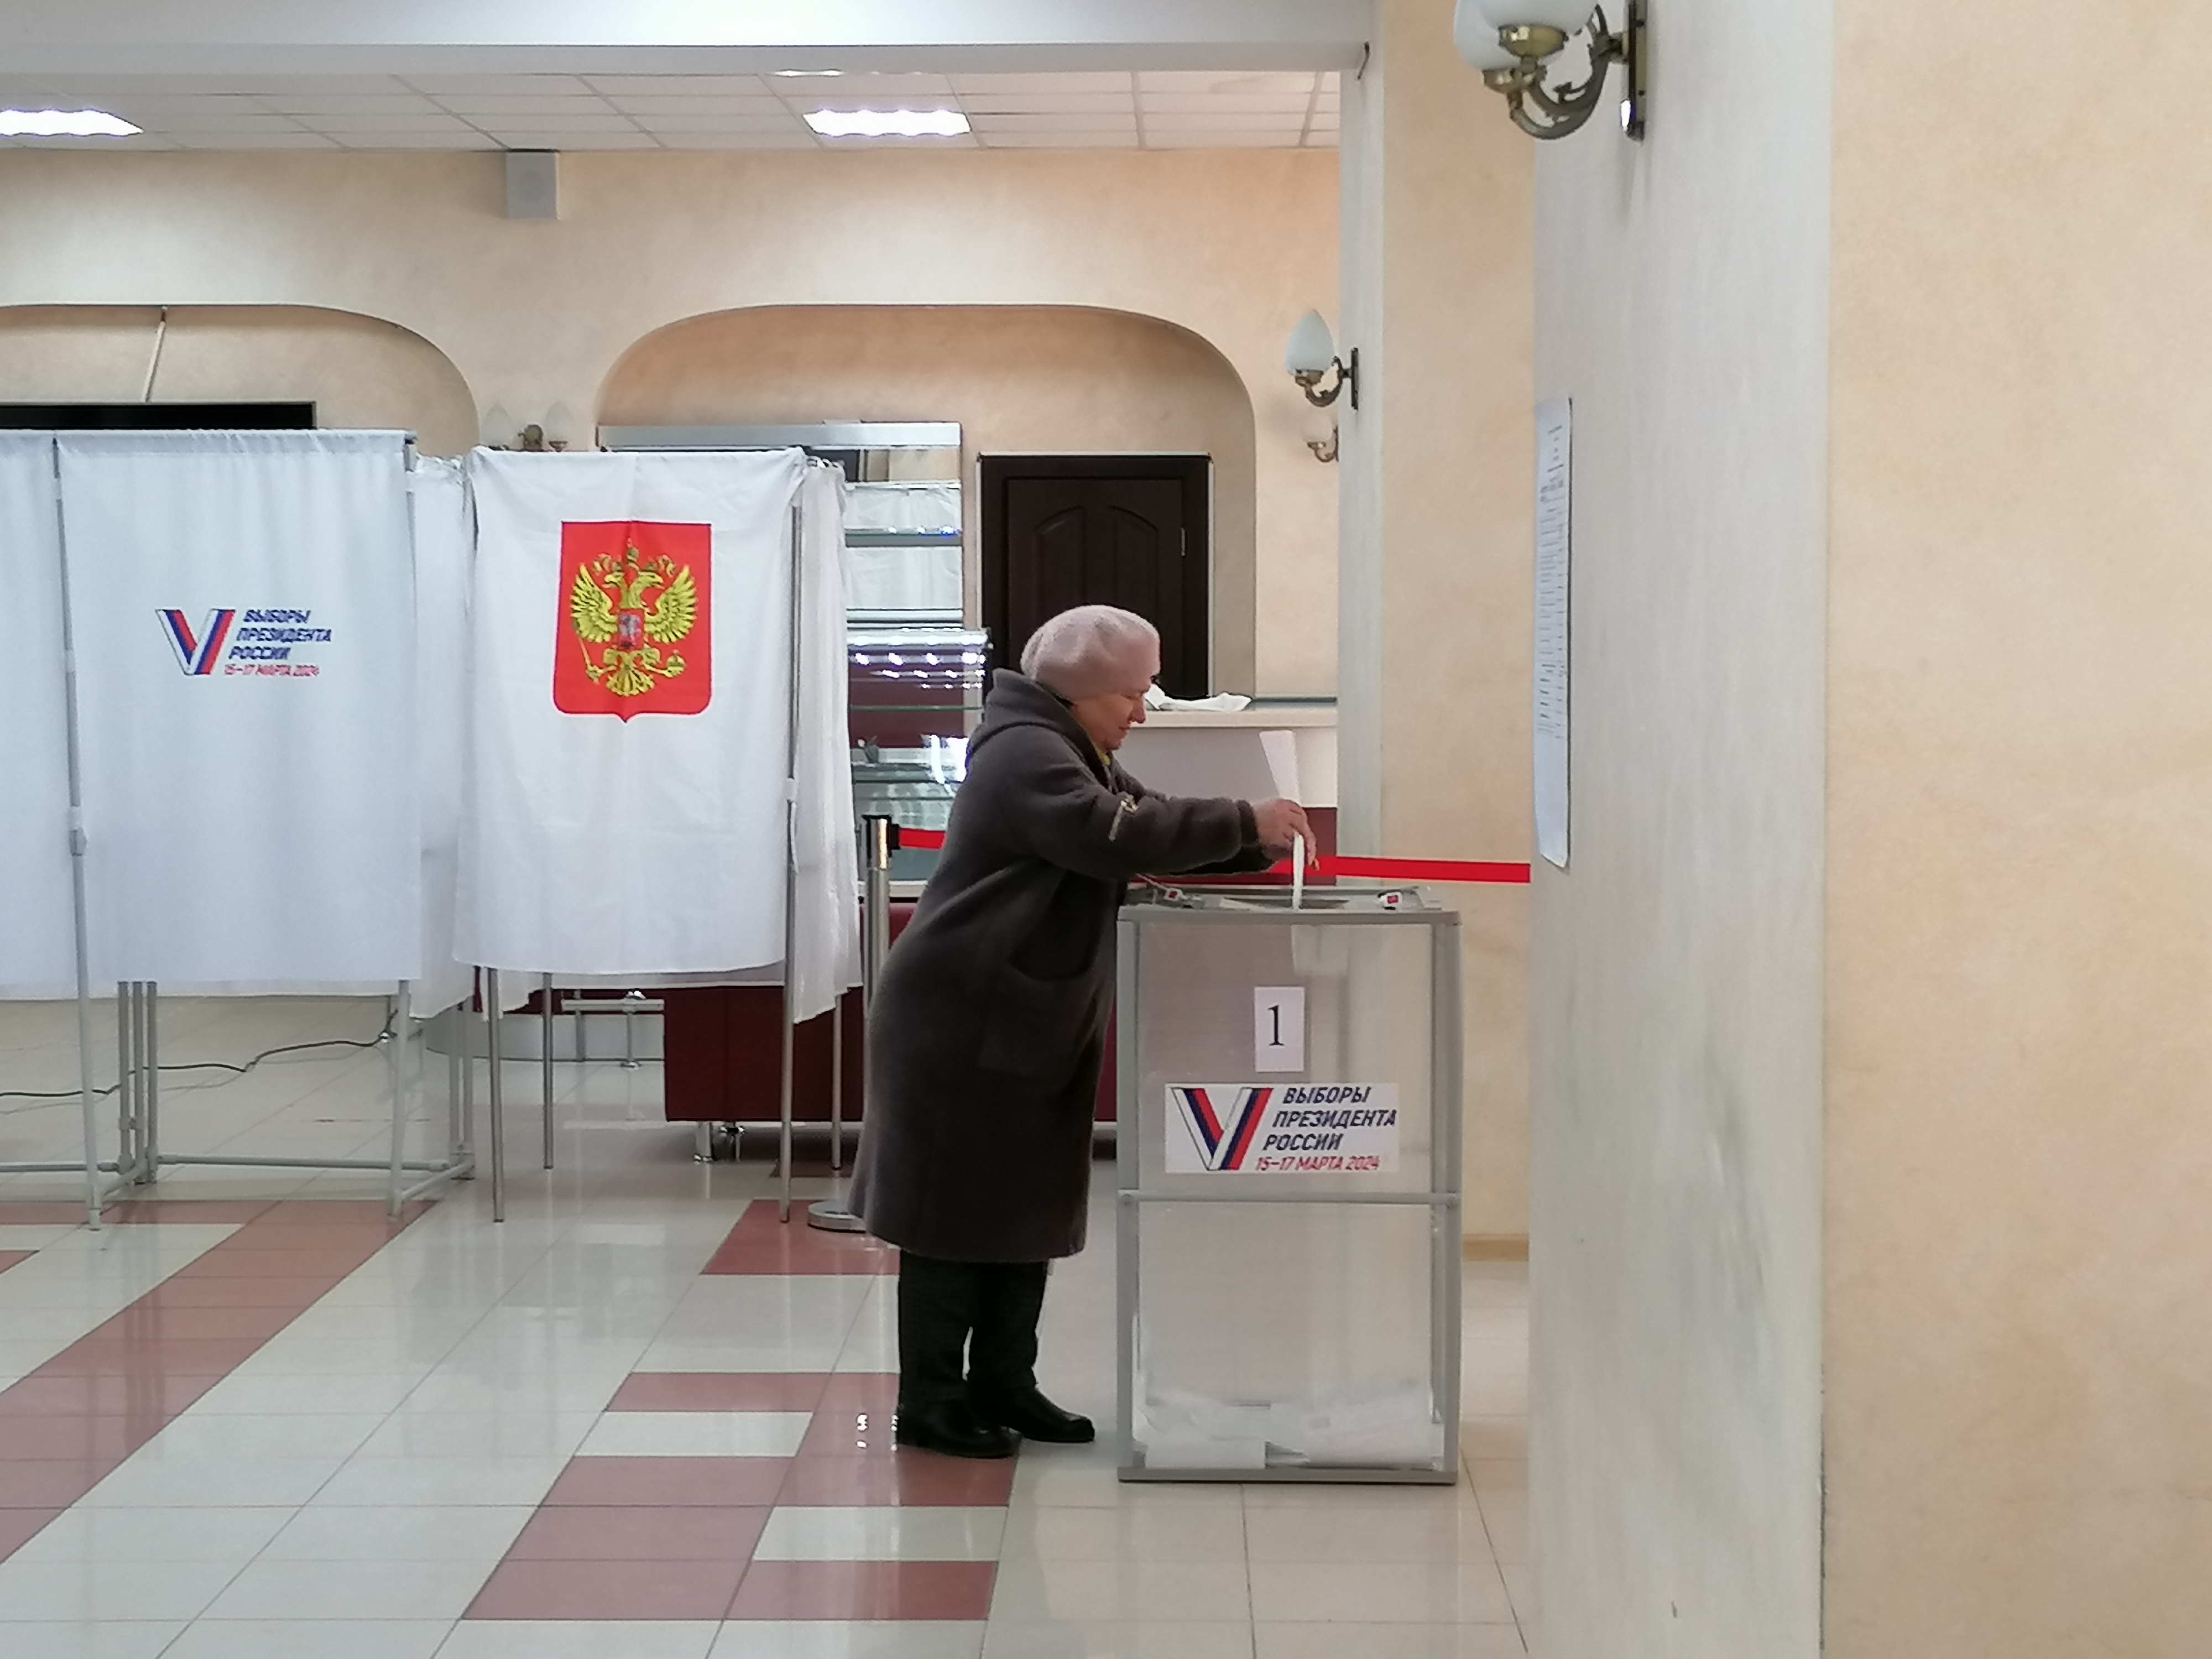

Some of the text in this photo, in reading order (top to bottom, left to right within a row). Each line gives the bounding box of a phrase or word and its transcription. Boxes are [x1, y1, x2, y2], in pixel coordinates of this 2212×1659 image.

[243, 609, 311, 624] ВЫБОРЫ
[236, 628, 332, 643] ПРЕЗИДЕНТА
[228, 646, 291, 660] РОССИИ
[1267, 1004, 1285, 1046] 1
[1282, 1086, 1371, 1104] ВЫБОРЫ
[1272, 1109, 1397, 1129] ПРЕЗИДЕНТА
[1262, 1133, 1344, 1150] РОССИИ
[1295, 1156, 1343, 1170] МАРТА
[1345, 1156, 1380, 1170] 2024
